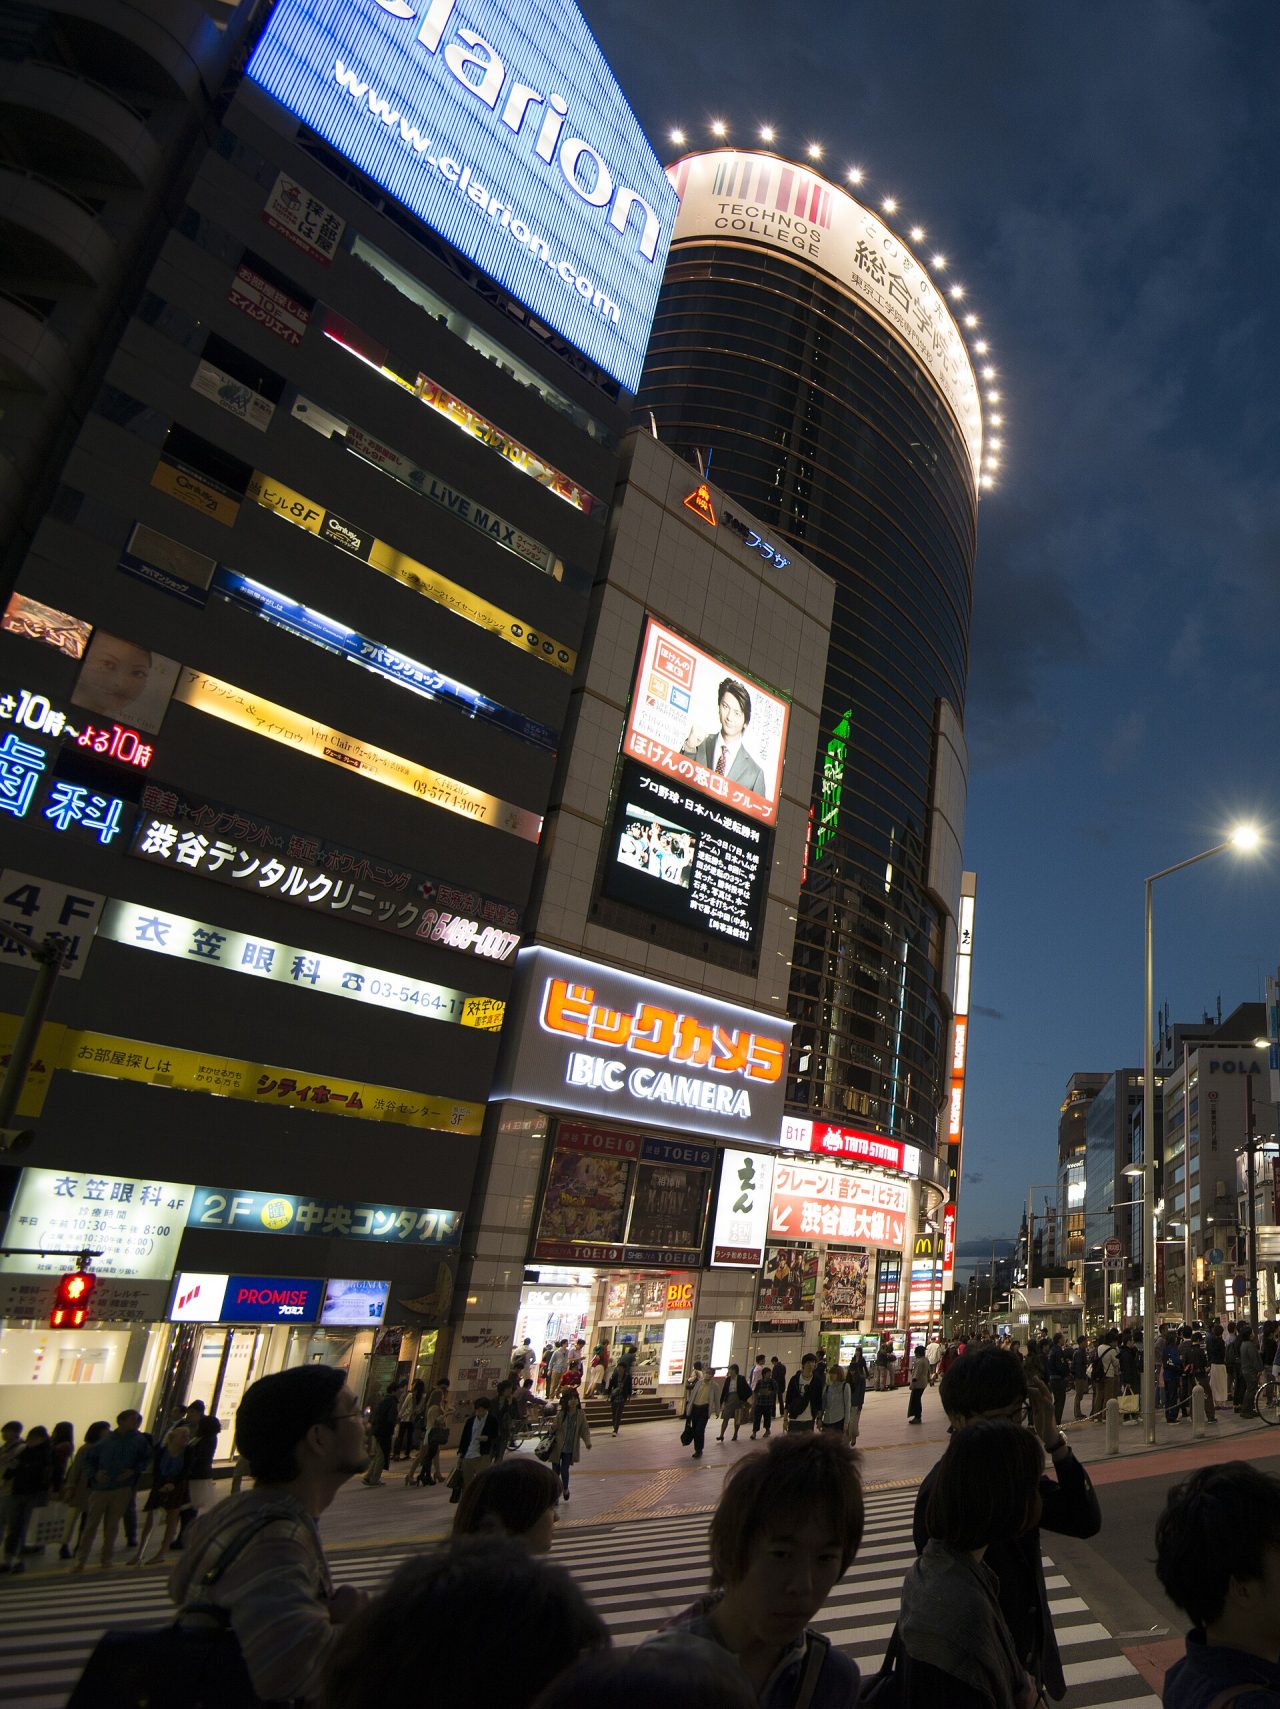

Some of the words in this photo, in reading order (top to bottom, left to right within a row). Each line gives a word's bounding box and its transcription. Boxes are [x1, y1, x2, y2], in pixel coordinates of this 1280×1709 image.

[335, 60, 622, 326] www.clarion.com
[297, 198, 325, 240] 探しは
[314, 213, 341, 255] お部屋
[715, 217, 820, 258] COLLEGE
[718, 203, 822, 243] TECHNOS
[239, 268, 310, 322] お部屋探しは
[228, 290, 301, 346] エイムクリエイト
[250, 480, 320, 522] 当ビル8F
[474, 506, 513, 545] MAX
[744, 529, 792, 569] プラザ
[359, 641, 446, 690] アパマンショップ
[188, 672, 245, 706] アイラッシュ
[245, 705, 257, 716] &
[255, 717, 304, 744] アイブロウ
[310, 726, 329, 743] Vert
[330, 736, 353, 751] Clair
[413, 779, 487, 819] 03-5774-3077
[640, 775, 761, 844] プロ野球・日本ハム逆転勝利
[732, 790, 774, 817] グループ
[141, 820, 419, 930] 渋谷デンタルクリニック
[325, 848, 412, 892] ホワイトニング
[136, 915, 323, 986] 衣笠眼科
[539, 977, 785, 1084] ビックカメラ
[77, 1045, 172, 1074] お部屋探しは
[256, 1074, 364, 1110] シティホーム
[373, 1098, 441, 1117] 渋谷センター
[566, 1052, 627, 1093] BIC
[628, 1066, 752, 1118] CAMERA
[1209, 1059, 1263, 1076] POLA
[583, 1133, 622, 1151] TOEI
[664, 1146, 699, 1162] TOEI
[786, 1125, 808, 1143] B1F
[54, 1176, 163, 1208] 衣笠眼科
[167, 1199, 185, 1210] 4F
[775, 1167, 835, 1196] クレーン!
[18, 1216, 39, 1226] 平日
[144, 1225, 171, 1237] 8:00
[79, 1206, 128, 1219] 診療時間
[201, 1194, 254, 1225] 2F
[295, 1202, 456, 1242] 中央コンタクト
[800, 1201, 892, 1242] 渋谷最大級!
[574, 1246, 608, 1259] TOEI
[658, 1251, 688, 1264] TOEI
[236, 1289, 309, 1306] PROMISE
[278, 1305, 304, 1315] プロミス
[666, 1300, 693, 1310] CAMERA
[667, 1282, 694, 1301] BIC
